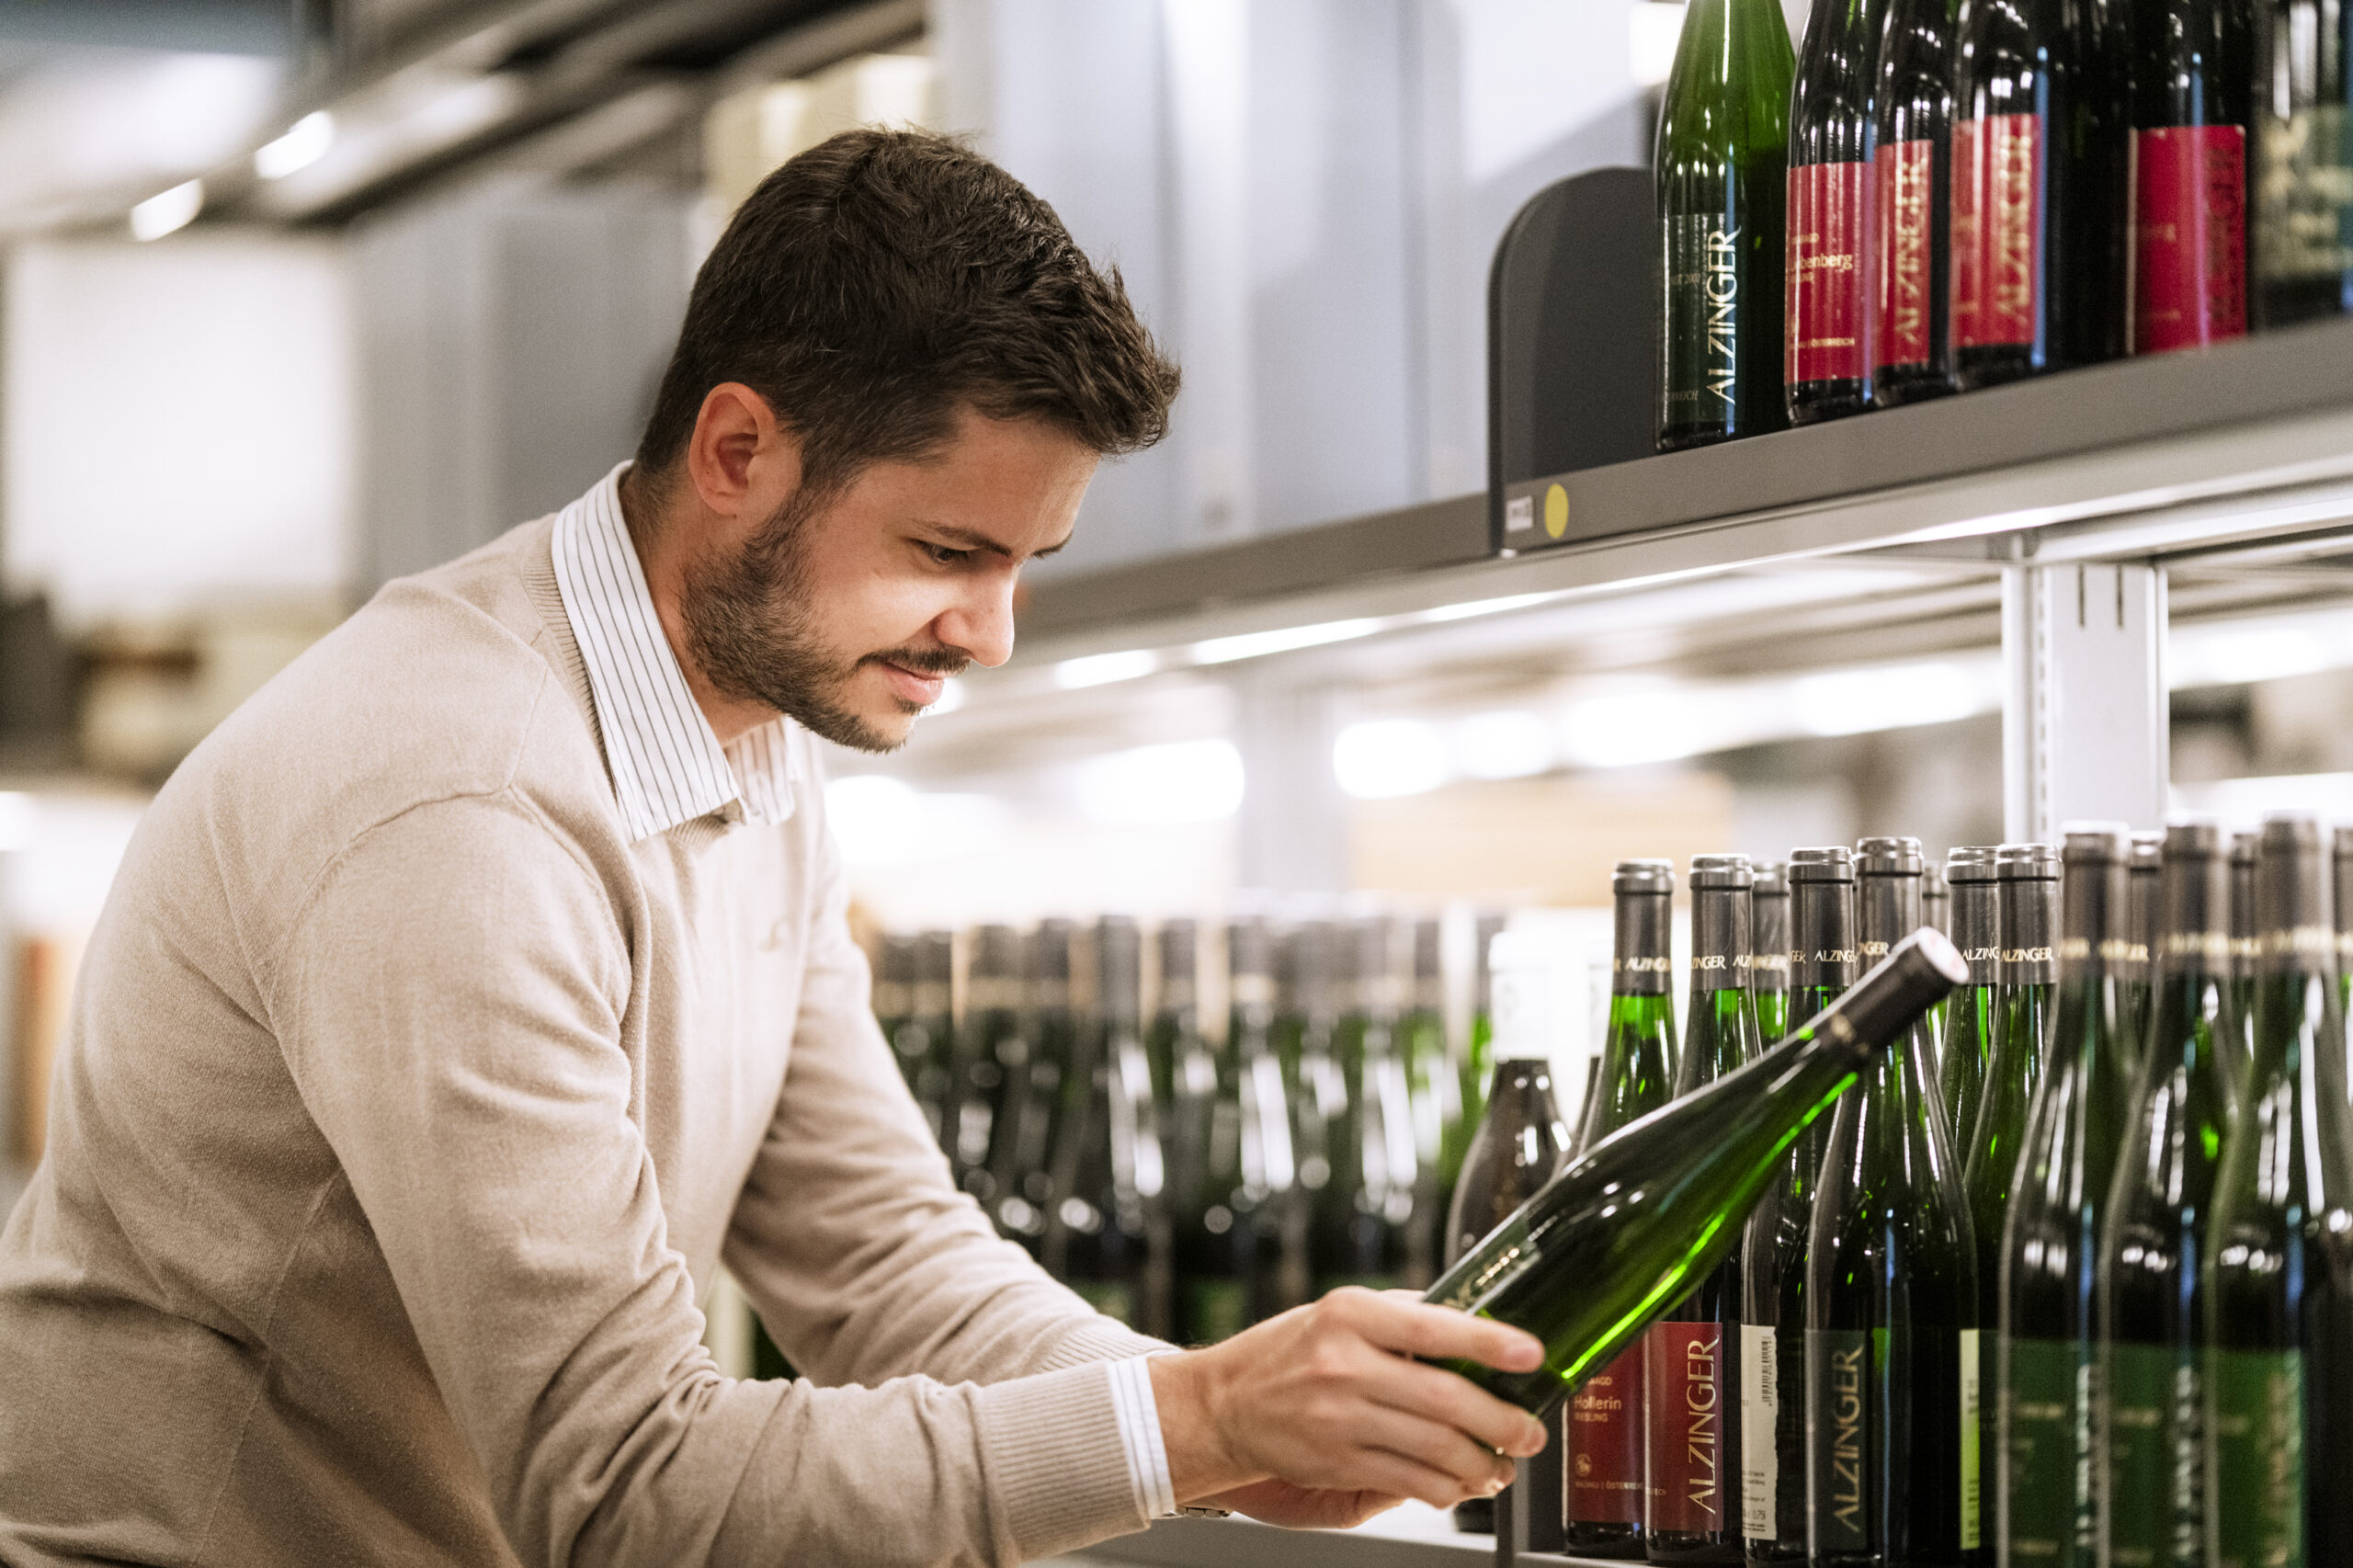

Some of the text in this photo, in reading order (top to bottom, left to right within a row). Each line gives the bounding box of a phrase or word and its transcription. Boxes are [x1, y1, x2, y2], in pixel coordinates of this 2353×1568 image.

[1706, 225, 1742, 405] ALZINGER
[2001, 946, 2054, 963] ALZINGER
[1574, 1395, 1622, 1411] Hollerin
[1687, 1334, 1720, 1516] ALZINGER
[1833, 1344, 1864, 1533] ALZINGER
